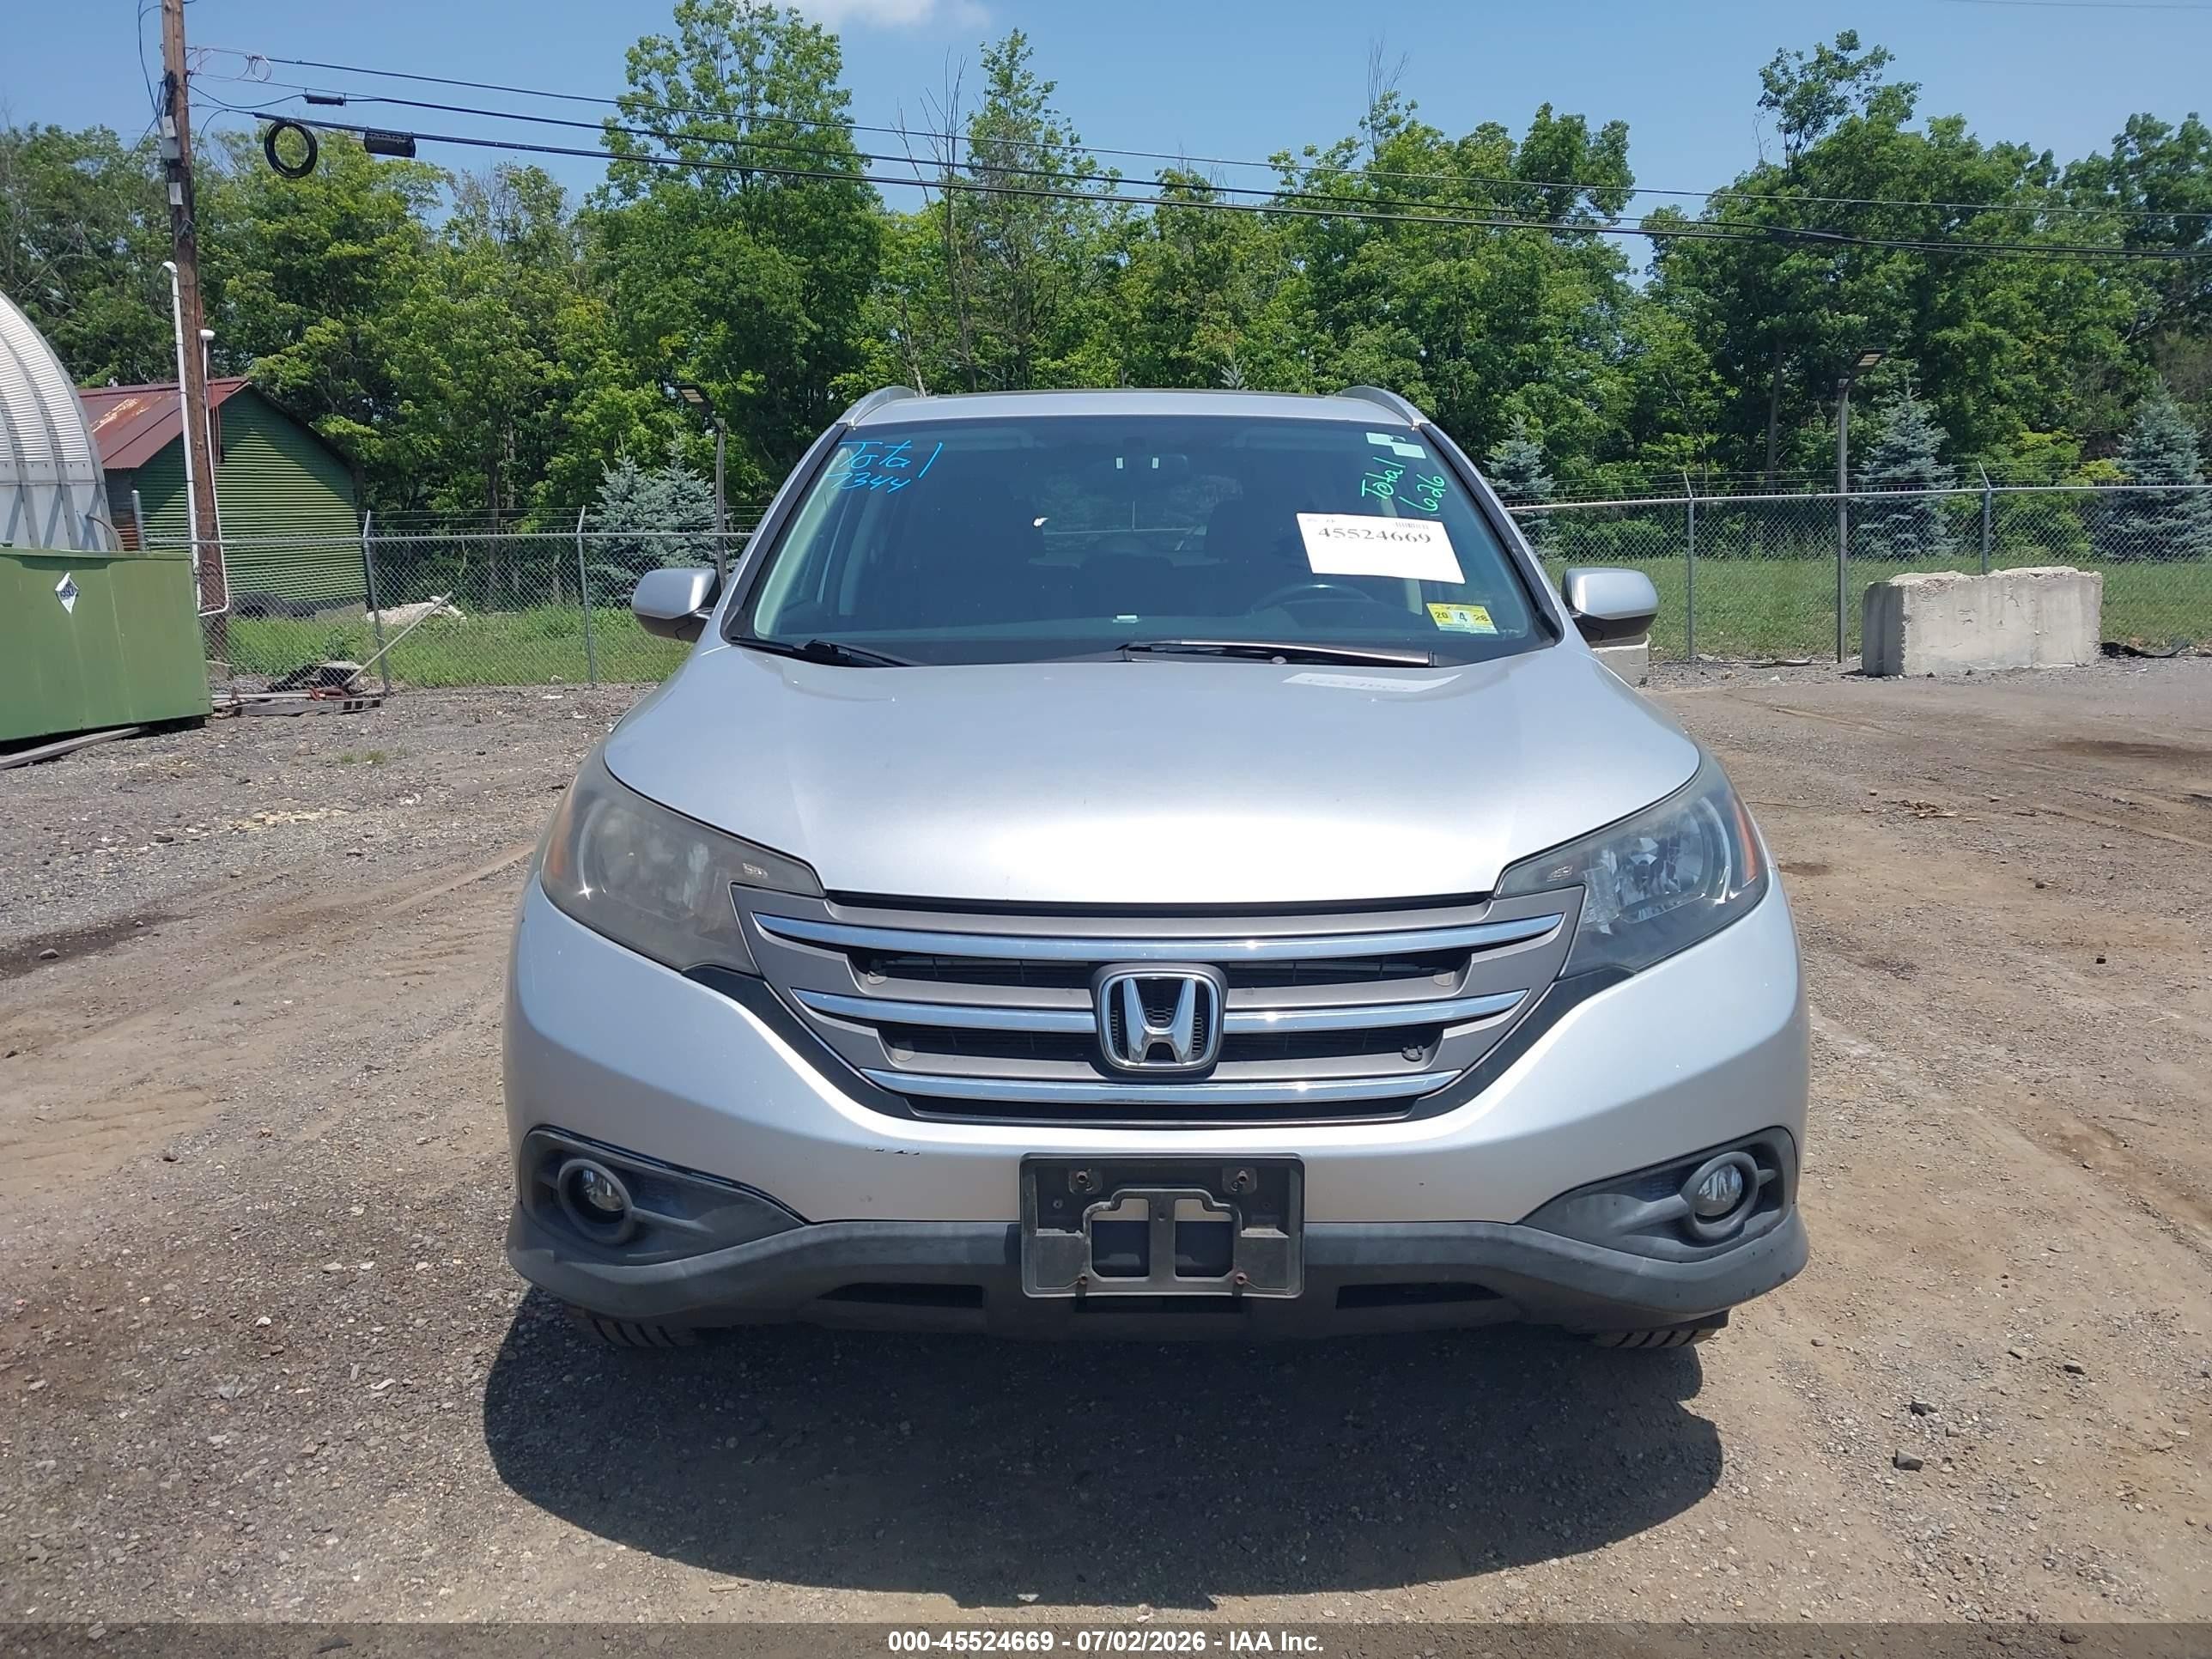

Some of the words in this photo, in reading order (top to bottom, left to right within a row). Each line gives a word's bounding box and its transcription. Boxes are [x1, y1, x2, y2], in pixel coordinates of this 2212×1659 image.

[838, 440, 944, 479] Total
[1360, 457, 1406, 499] Total
[1399, 473, 1447, 512] 626
[1318, 526, 1431, 544] 45524669
